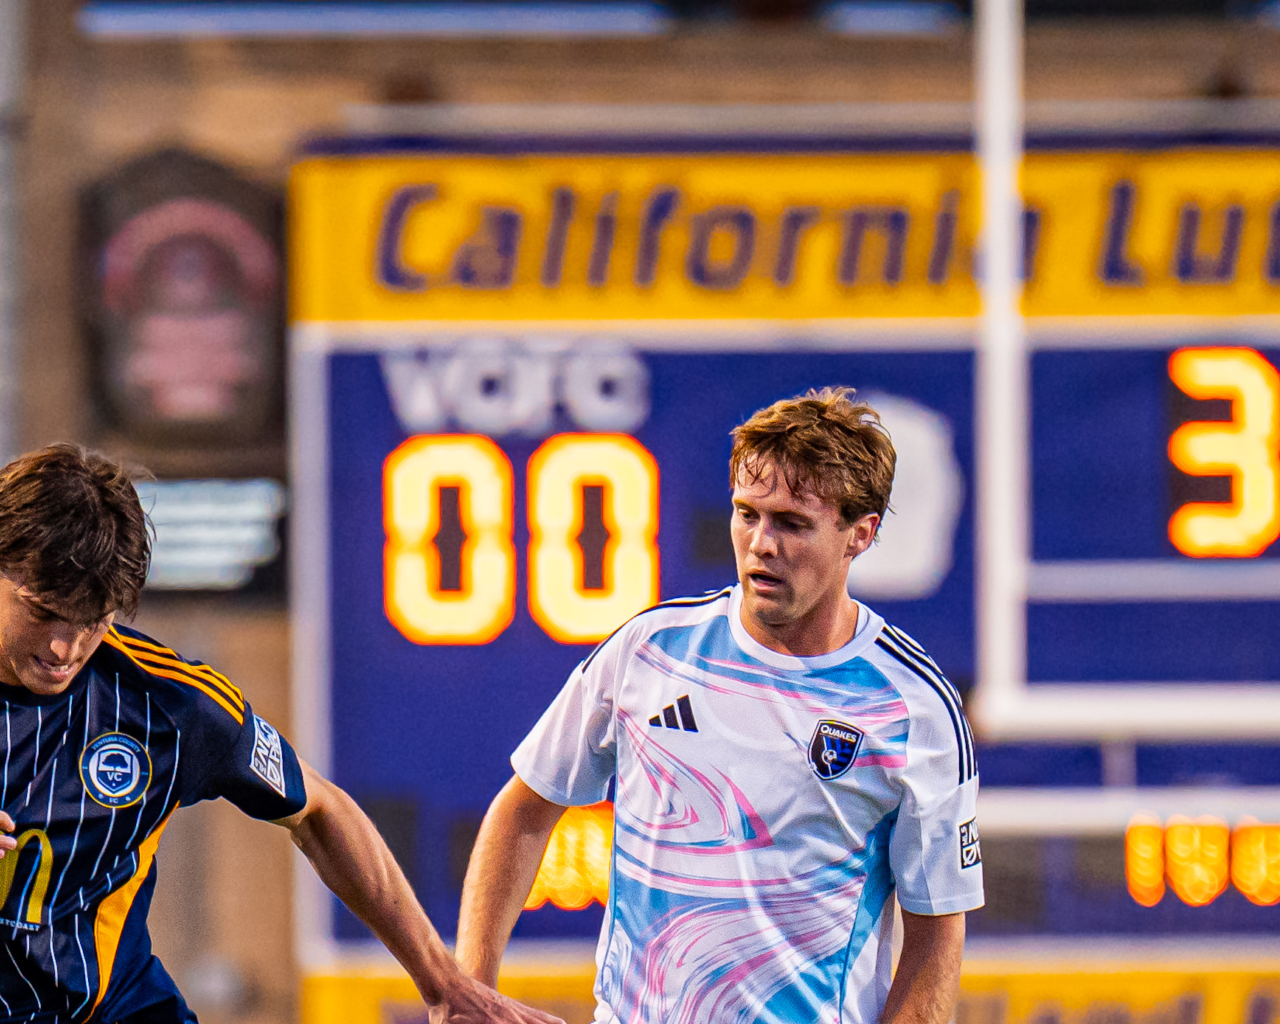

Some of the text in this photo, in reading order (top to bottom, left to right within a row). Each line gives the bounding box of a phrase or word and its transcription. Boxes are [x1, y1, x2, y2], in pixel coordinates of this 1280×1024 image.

[382, 432, 661, 646] 00
[821, 725, 857, 743] QUAKES
[107, 771, 123, 781] VC
